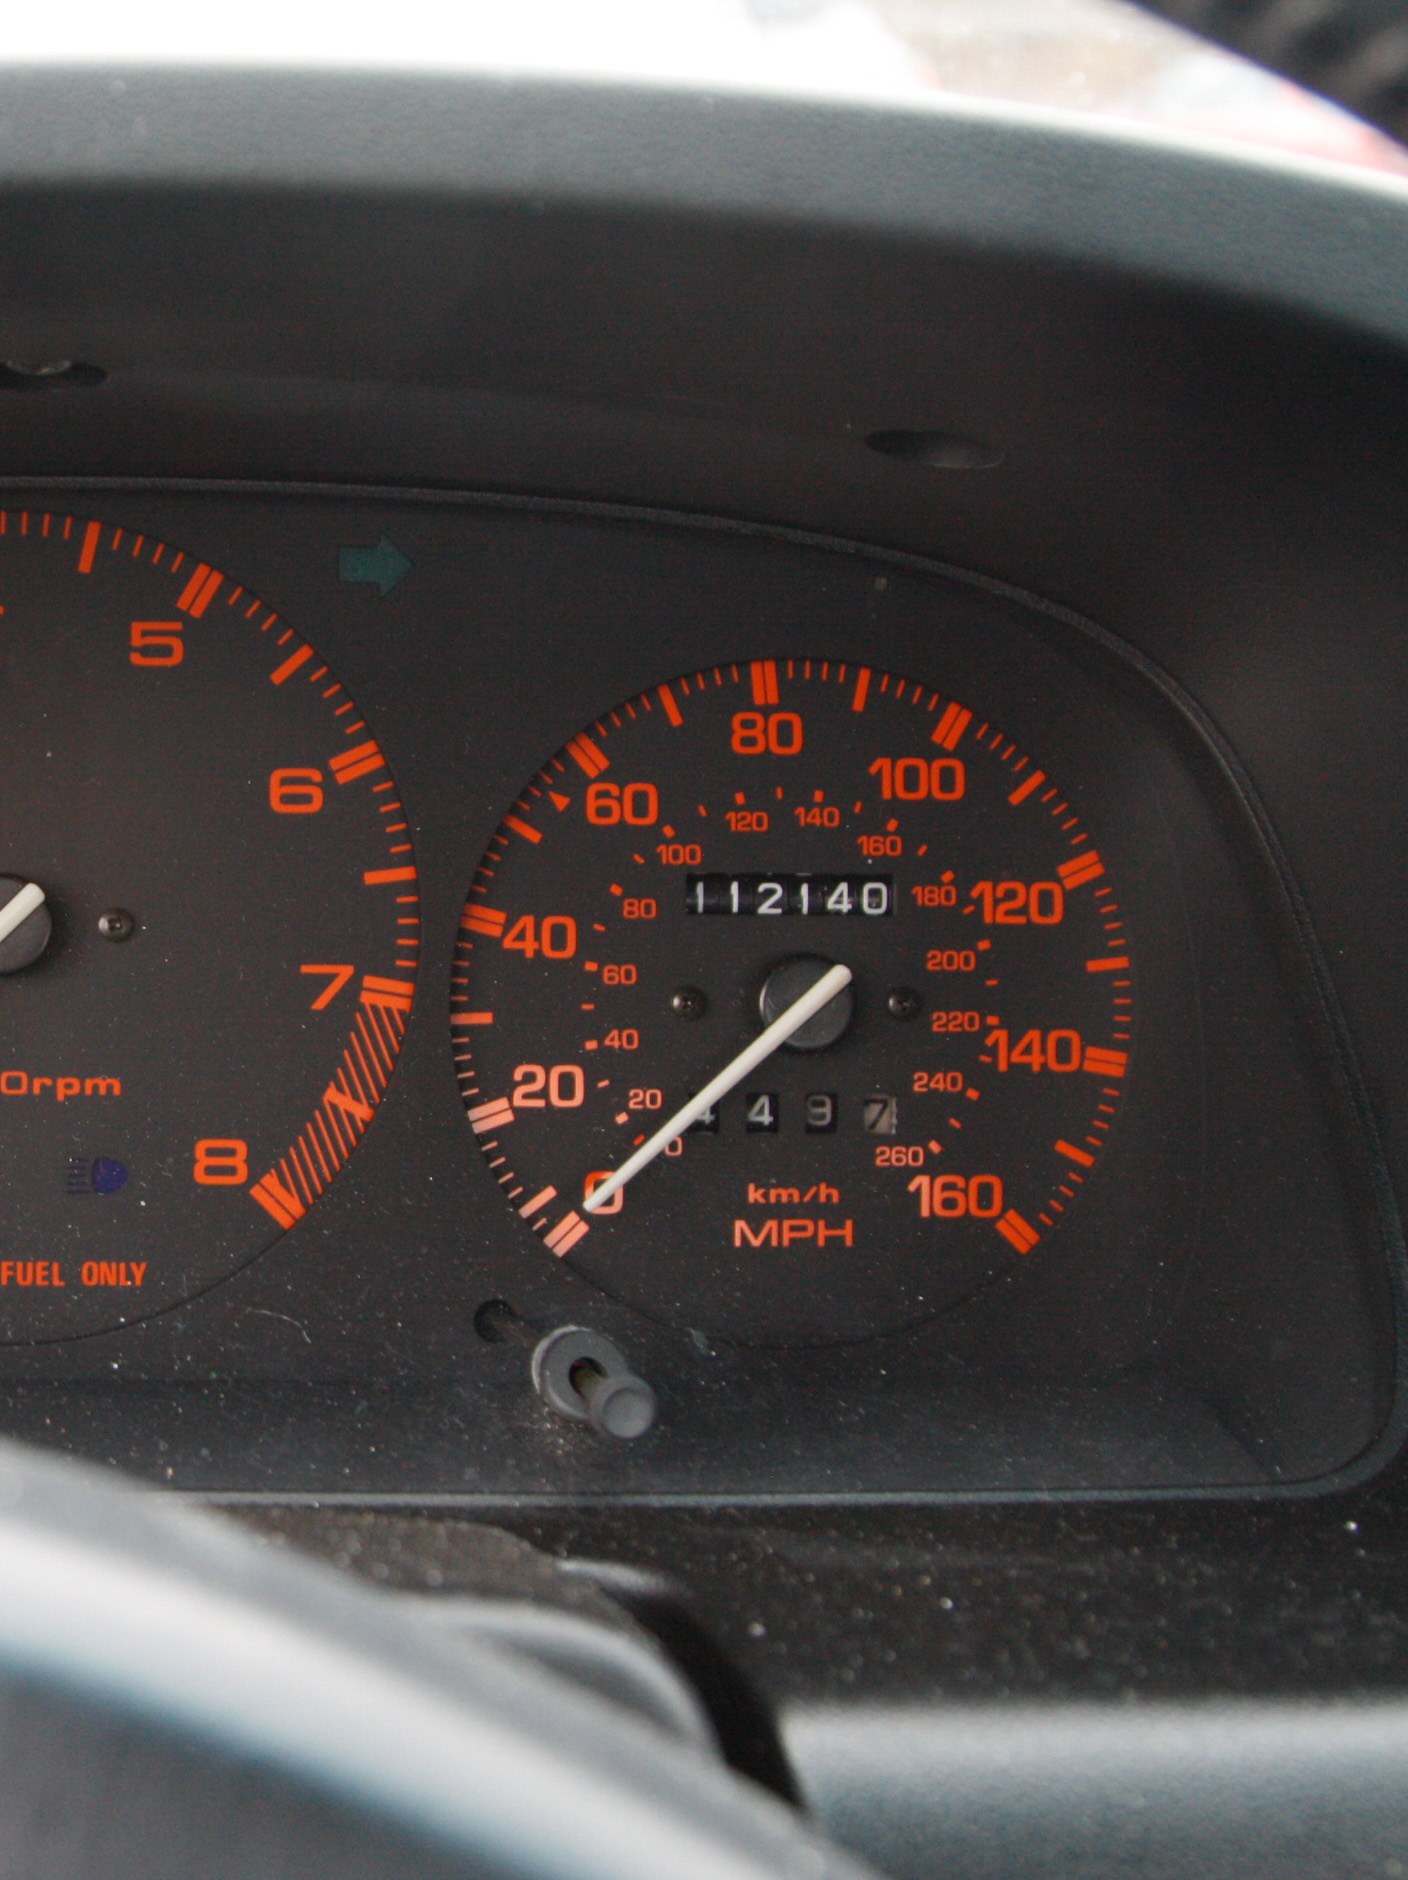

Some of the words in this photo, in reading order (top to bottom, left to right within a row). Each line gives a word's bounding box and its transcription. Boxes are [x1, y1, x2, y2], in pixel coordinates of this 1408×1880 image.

[130, 622, 184, 666] 5
[732, 712, 803, 754] 80
[870, 758, 965, 800] 100
[270, 768, 323, 813] 6
[587, 783, 658, 825] 60
[726, 812, 769, 832] 120
[795, 807, 840, 827] 140
[657, 844, 702, 864] 100
[858, 836, 902, 856] 160
[913, 886, 957, 906] 180
[971, 881, 1063, 924] 120
[623, 899, 657, 919] 80
[503, 915, 577, 958] 40
[927, 950, 976, 970] 200
[603, 965, 638, 984] 60
[300, 964, 354, 1010] 7
[933, 1012, 980, 1031] 220
[604, 1029, 640, 1049] 40
[986, 1030, 1082, 1072] 140
[513, 1065, 585, 1107] 20
[914, 1072, 963, 1092] 240
[629, 1089, 662, 1109] 20
[665, 1136, 683, 1157] 0
[875, 1146, 924, 1166] 260
[194, 1139, 248, 1185] 8
[748, 1183, 840, 1203] km/h
[909, 1175, 1003, 1217] 160
[735, 1219, 853, 1246] MPH
[1, 1261, 65, 1286] FUEL
[82, 1261, 147, 1286] ONLY
